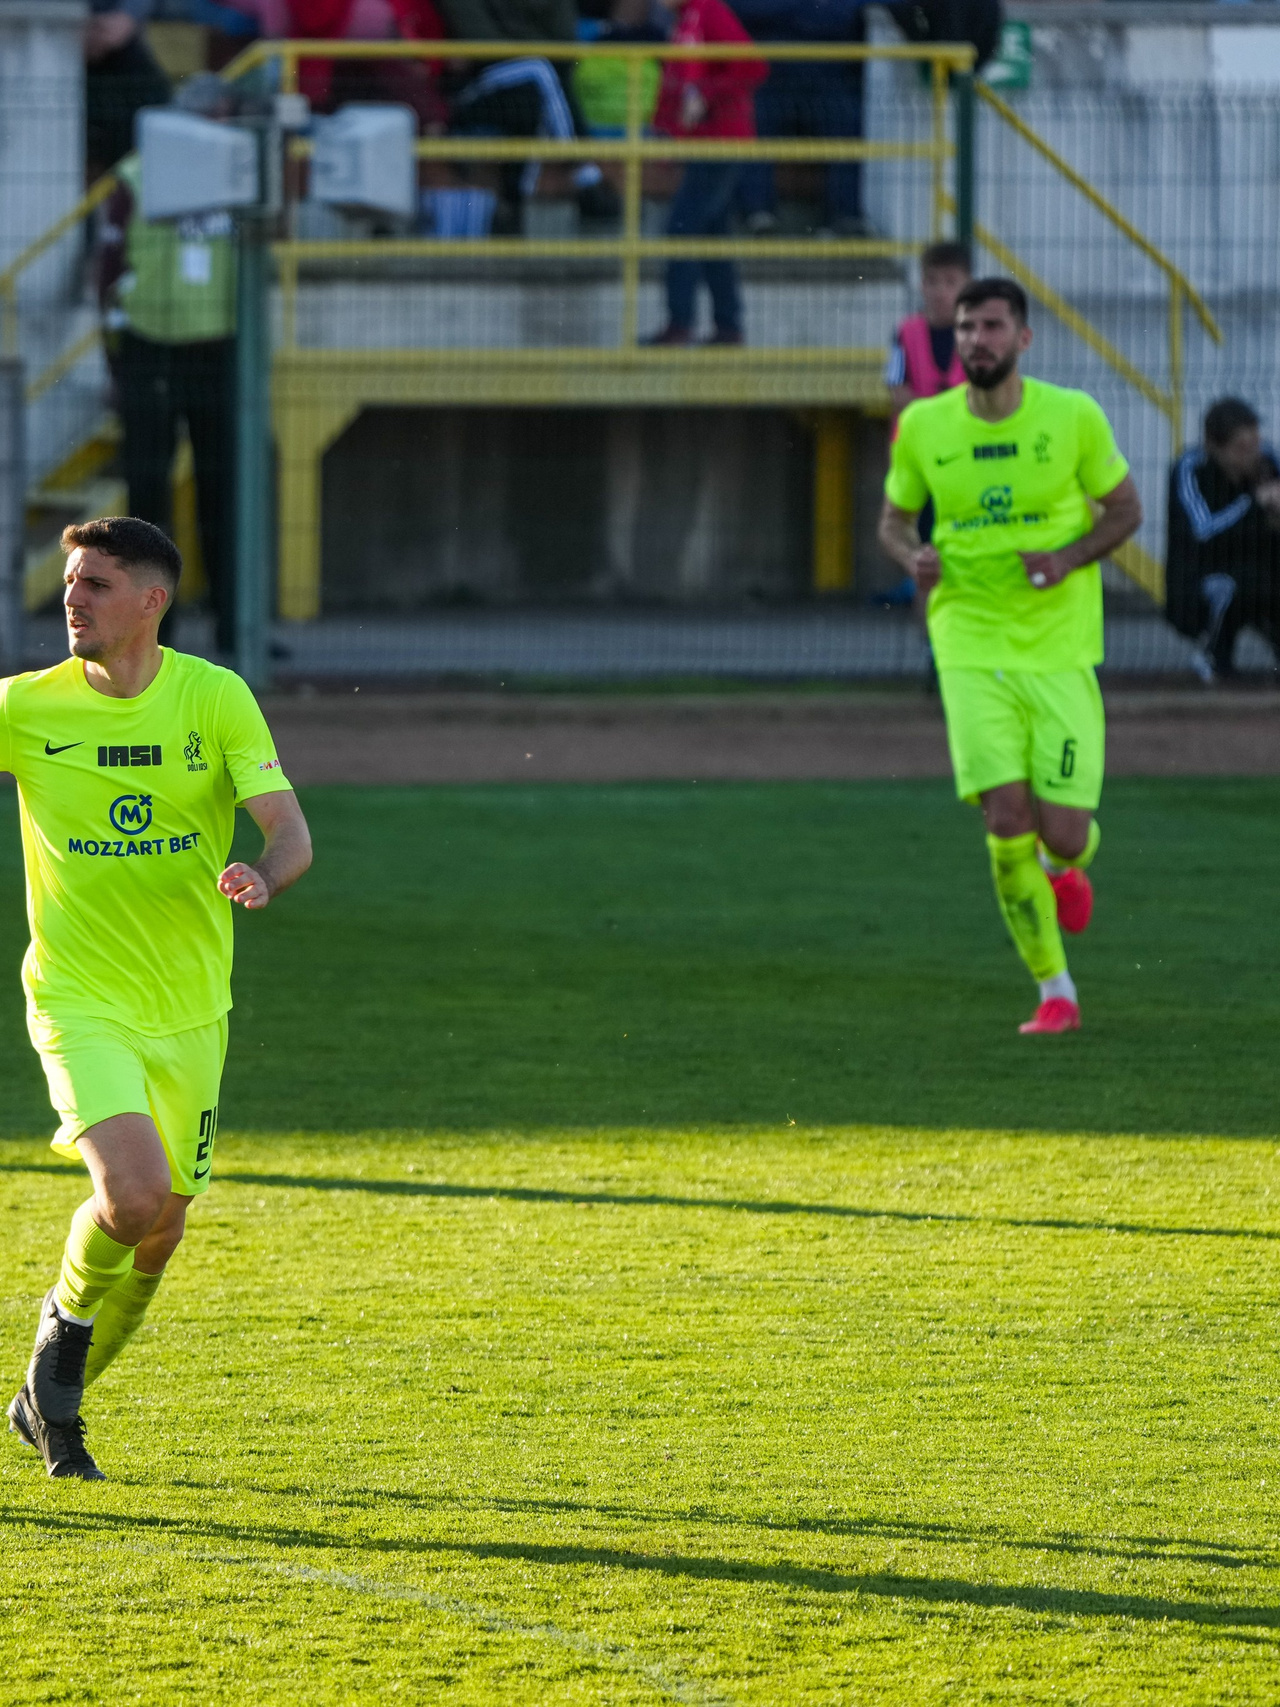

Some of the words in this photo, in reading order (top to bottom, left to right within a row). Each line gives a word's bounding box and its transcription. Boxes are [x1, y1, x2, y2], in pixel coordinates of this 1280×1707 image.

[1061, 738, 1077, 778] 6
[69, 837, 164, 857] MOZZART
[169, 833, 200, 853] BET
